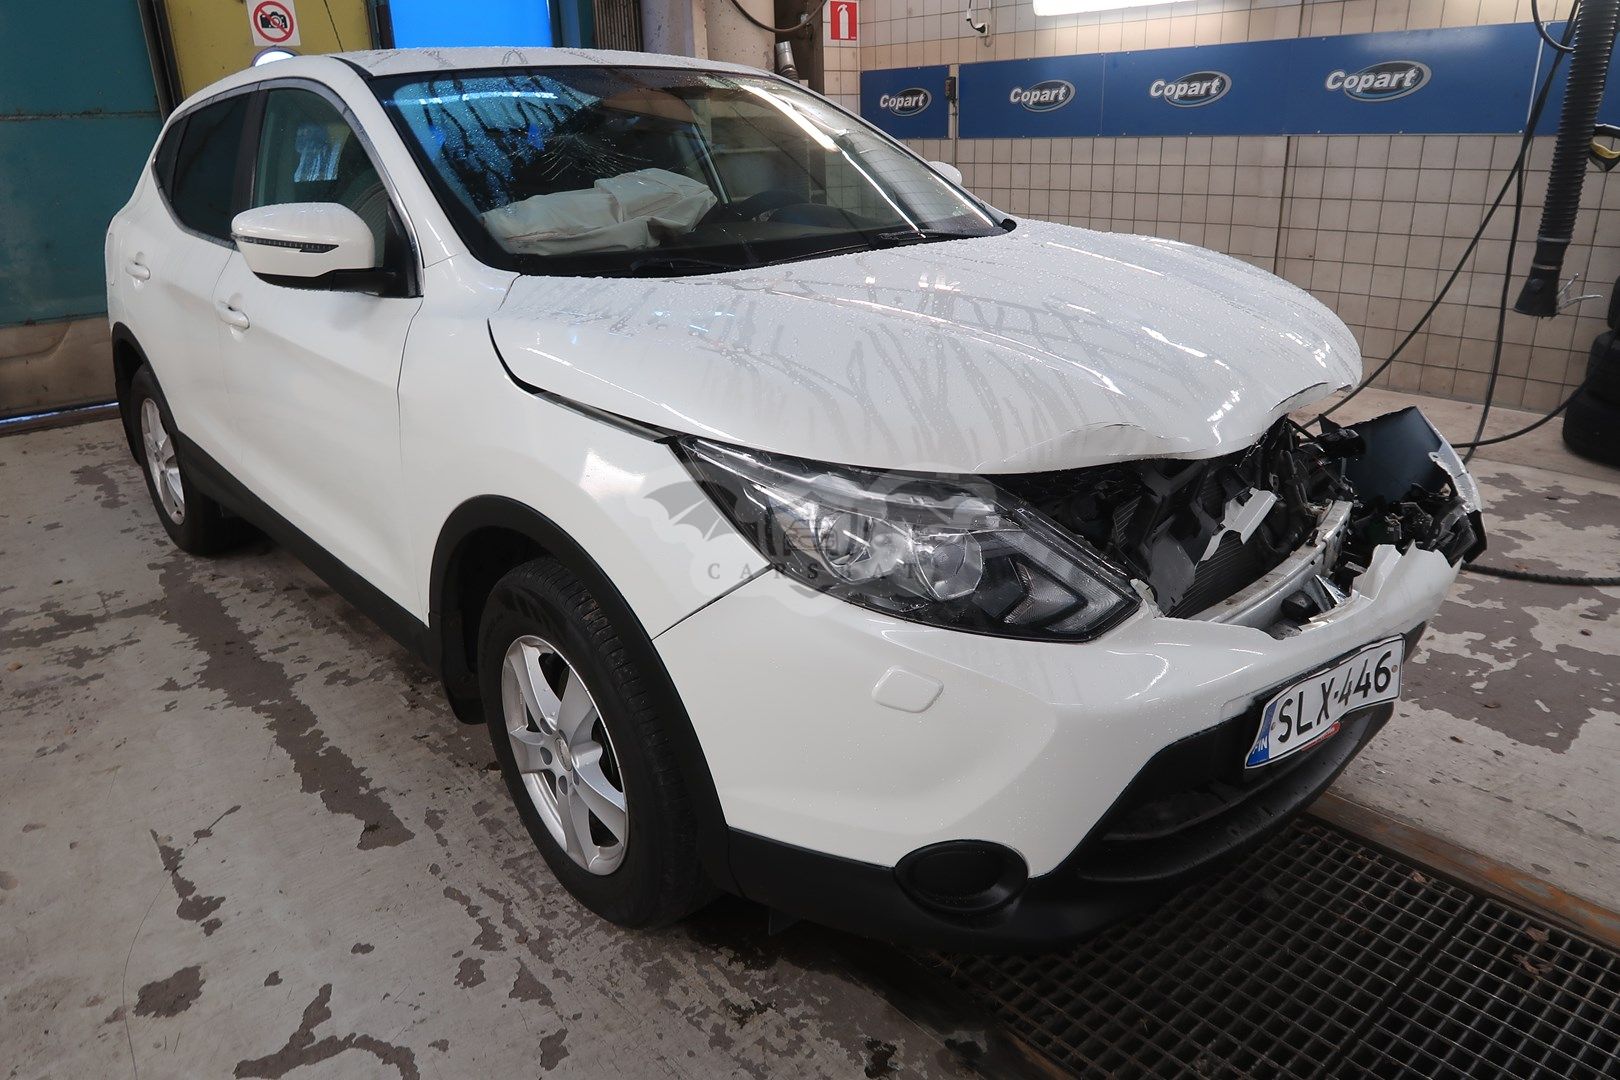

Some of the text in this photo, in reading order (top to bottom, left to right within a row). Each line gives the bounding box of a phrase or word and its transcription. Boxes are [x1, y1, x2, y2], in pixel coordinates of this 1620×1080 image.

[1150, 77, 1220, 100] Copart
[1326, 66, 1419, 93] Copart
[880, 92, 925, 110] Copart
[1010, 86, 1066, 105] Copart
[1277, 650, 1393, 744] SLX-446
